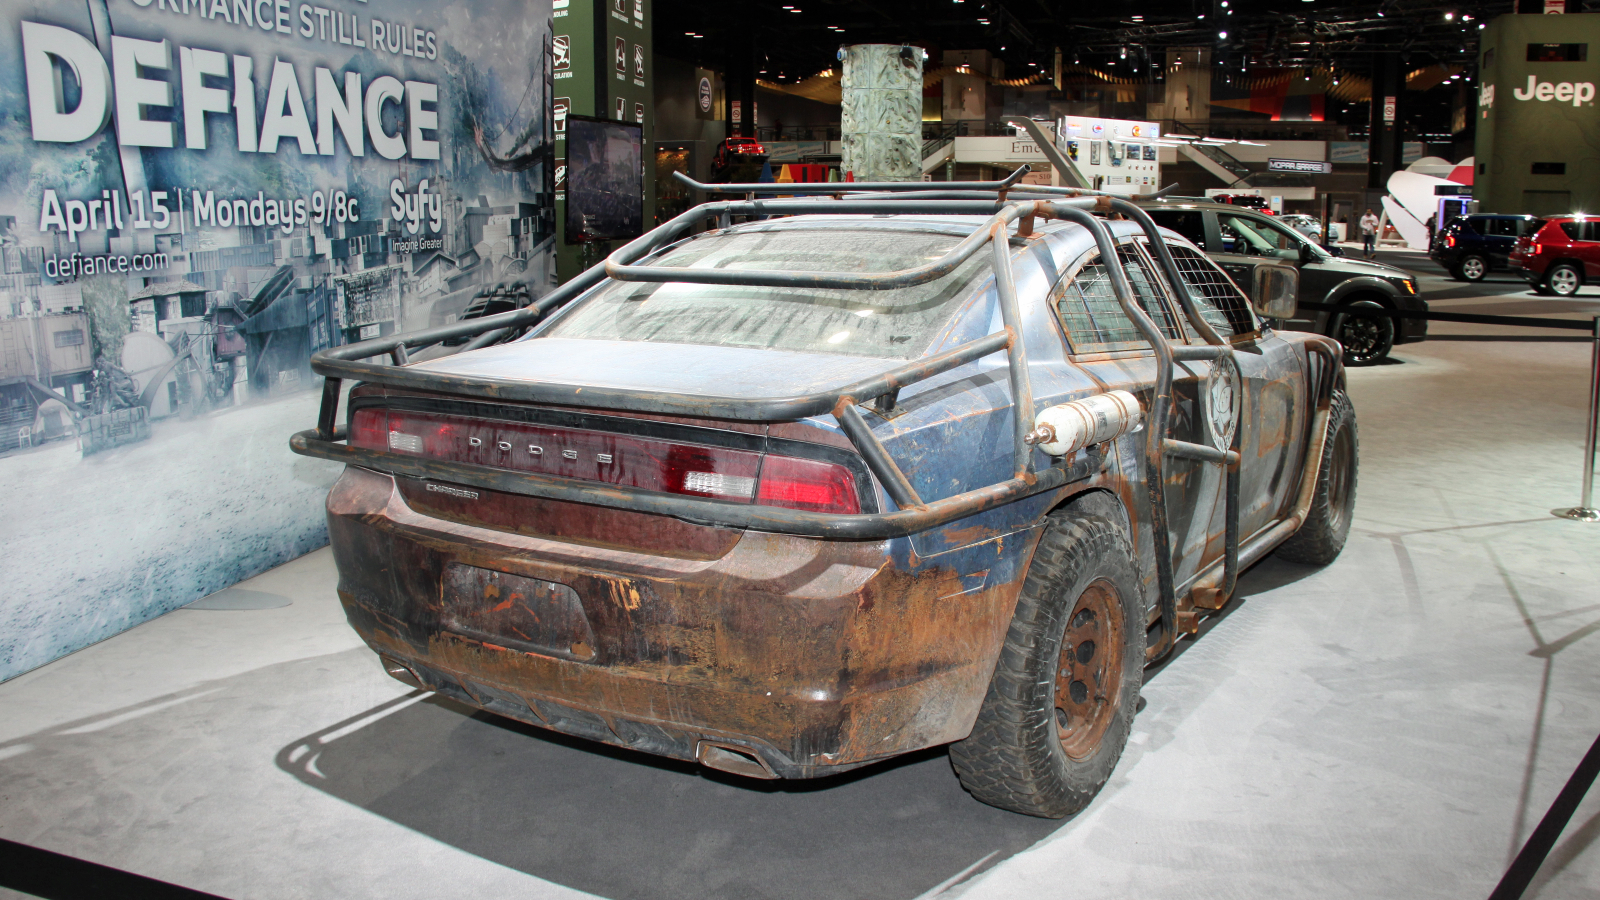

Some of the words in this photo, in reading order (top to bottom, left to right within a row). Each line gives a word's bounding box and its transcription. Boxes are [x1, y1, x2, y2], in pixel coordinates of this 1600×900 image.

[131, 0, 292, 34] MANCE
[299, 4, 366, 49] STILL
[371, 19, 437, 61] RULES
[20, 20, 441, 161] DEFIANCE
[1479, 81, 1495, 108] Jeep
[1513, 74, 1596, 107] Jeep
[39, 189, 123, 242] April
[132, 189, 171, 229] 15
[192, 190, 306, 234] Mondays
[312, 188, 360, 227] 9/8c
[390, 178, 442, 234] Syfy
[392, 239, 419, 253] Imagine
[419, 237, 443, 249] Greater
[45, 253, 169, 278] defiance.com
[468, 436, 613, 463] DODGE
[425, 483, 479, 500] CHARGER
